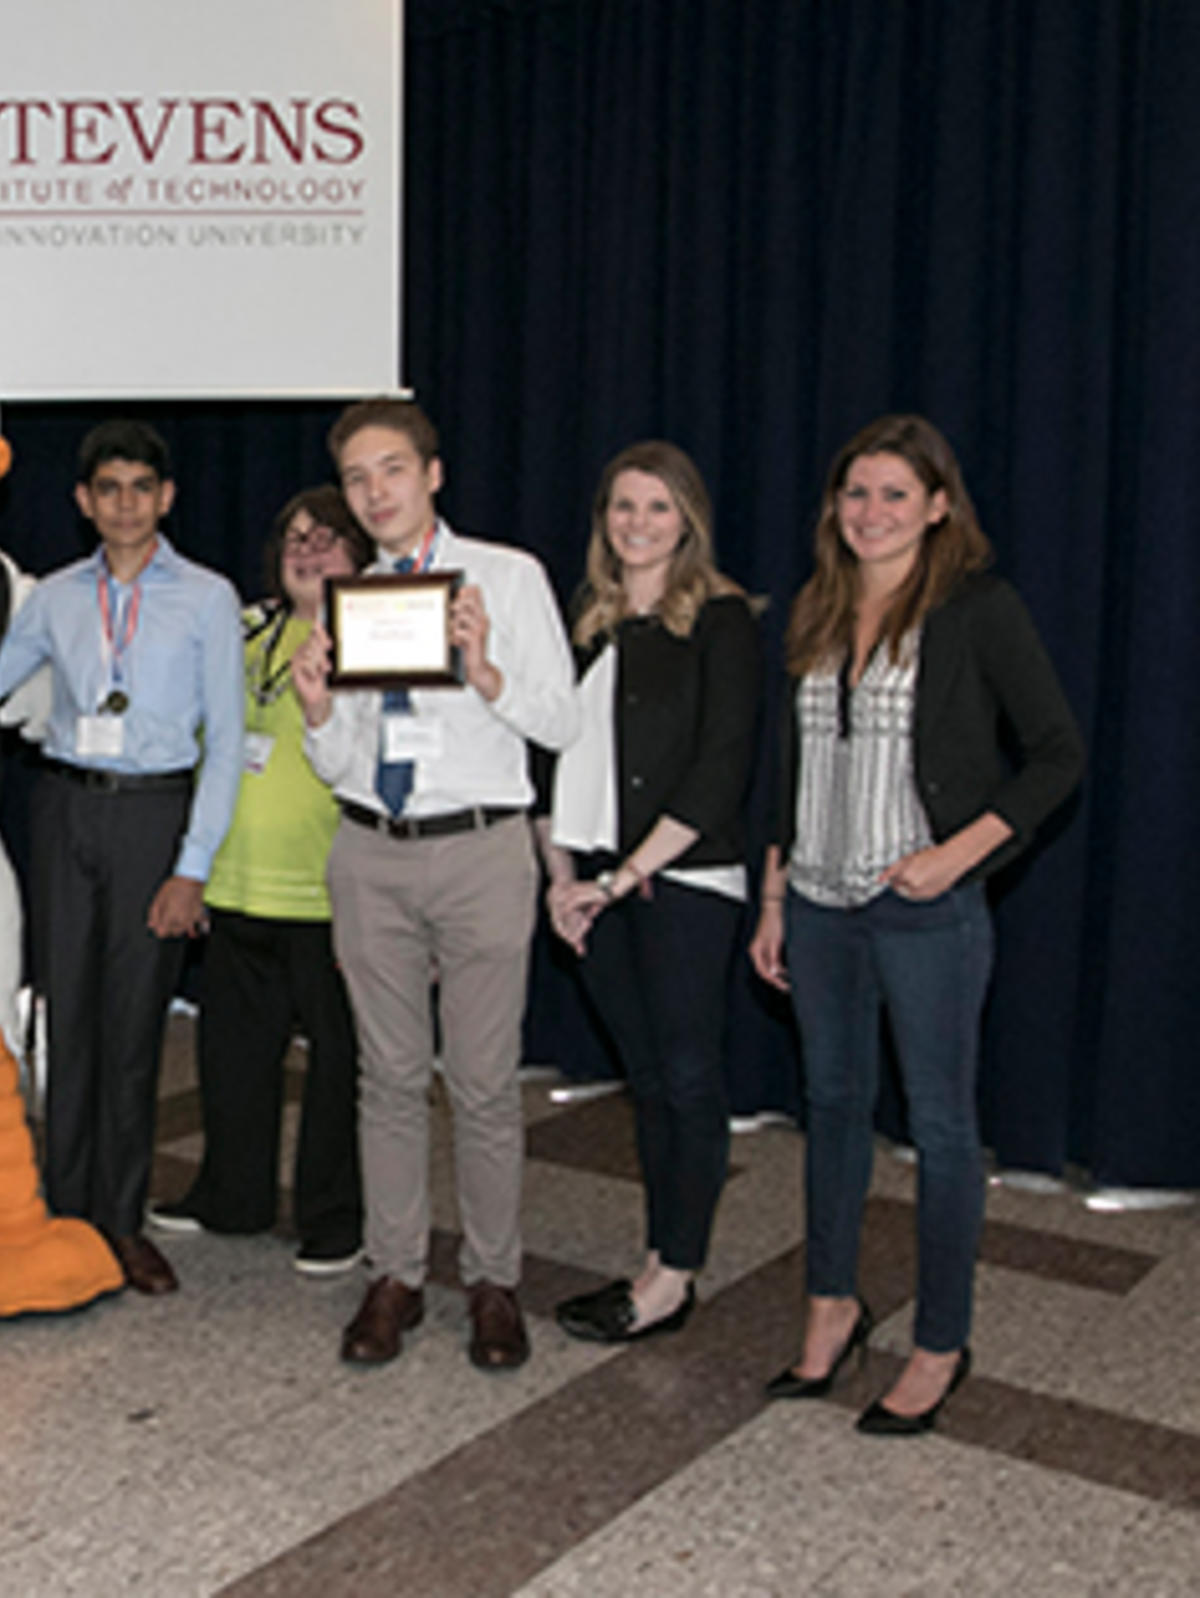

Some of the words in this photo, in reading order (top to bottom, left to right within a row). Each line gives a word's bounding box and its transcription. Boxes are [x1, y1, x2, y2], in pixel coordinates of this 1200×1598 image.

[104, 175, 134, 204] of
[146, 177, 365, 204] TECHNOLOGY
[187, 221, 366, 247] UNIVERSITY
